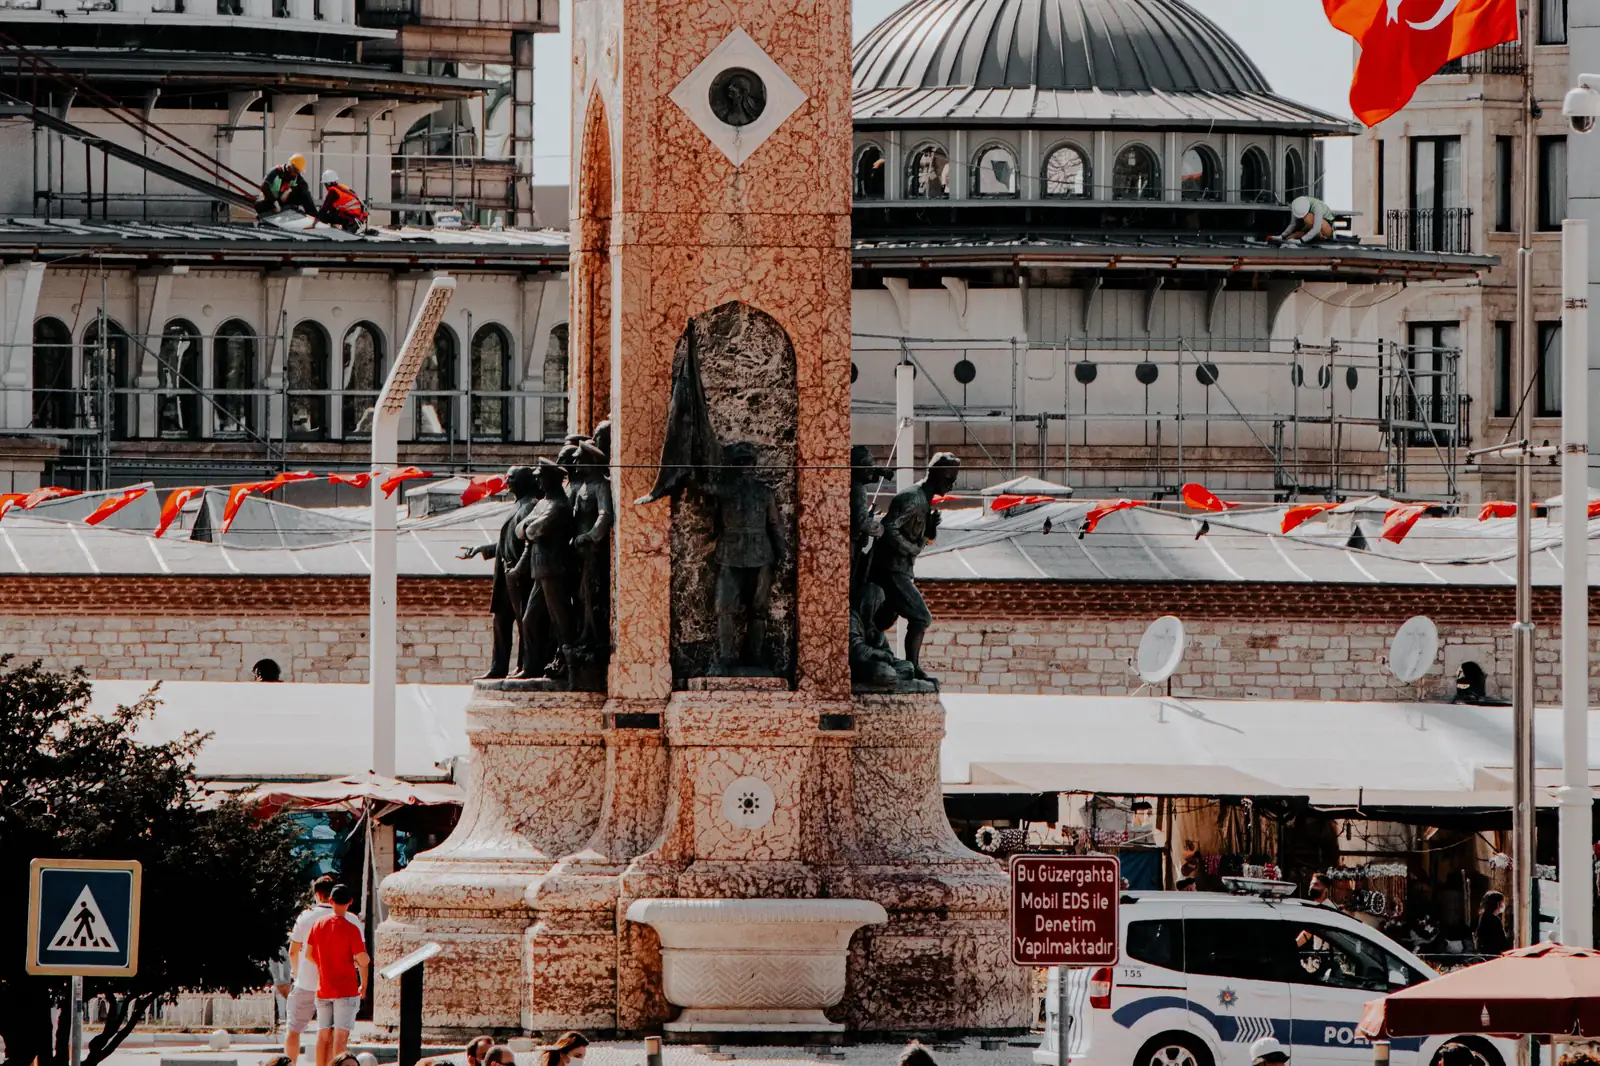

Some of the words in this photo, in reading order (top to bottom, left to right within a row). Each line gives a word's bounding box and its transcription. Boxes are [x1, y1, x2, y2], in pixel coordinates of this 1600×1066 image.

[1018, 864, 1035, 882] Bu
[1038, 864, 1114, 887] Güzergahta
[1021, 892, 1058, 909] Mobil
[1062, 892, 1090, 909] EDS
[1093, 892, 1109, 909] ile
[1035, 914, 1096, 932] Denetim
[1016, 936, 1114, 959] Yapılmaktadır
[1124, 969, 1142, 978] 155
